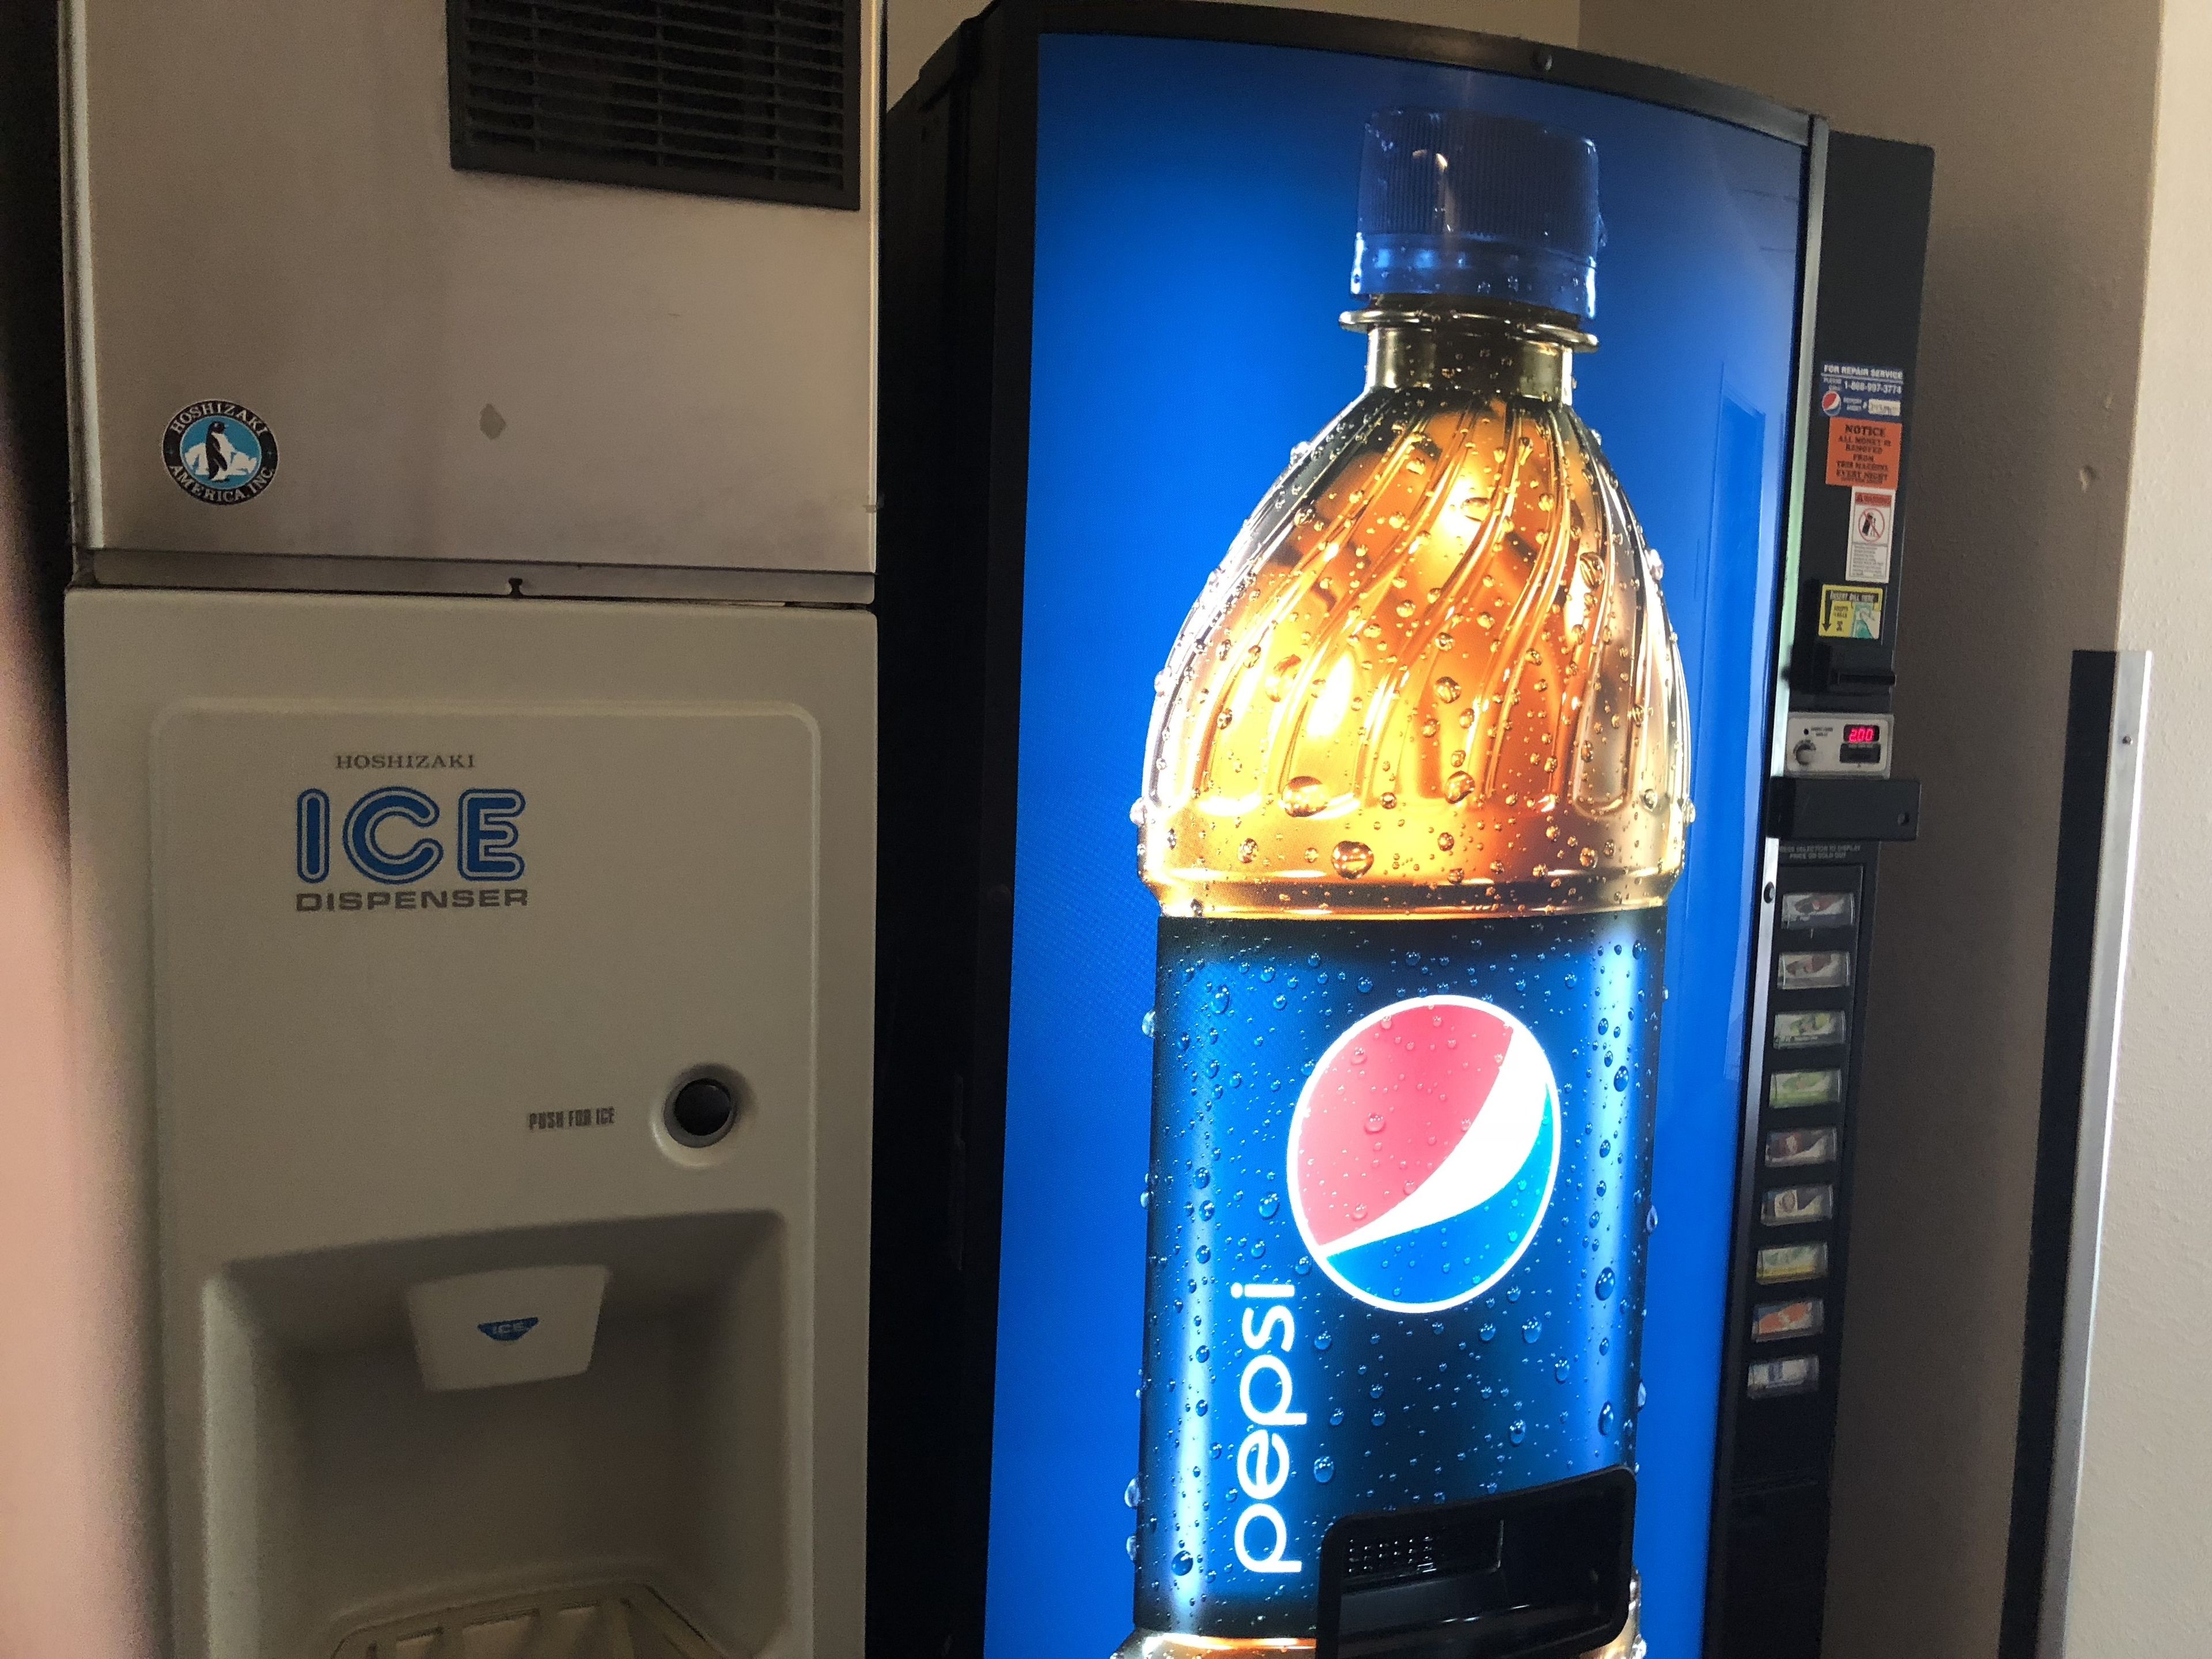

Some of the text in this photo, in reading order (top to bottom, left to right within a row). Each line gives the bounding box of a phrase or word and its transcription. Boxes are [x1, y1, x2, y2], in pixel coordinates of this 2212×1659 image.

[1824, 364, 1903, 380] FOR REPAIR SERVICE
[171, 403, 268, 435] HOSHIZAKI
[1845, 425, 1886, 437] NOTICE
[1855, 436, 1881, 446] MONEY
[1853, 454, 1874, 462] FROM
[335, 753, 475, 770] HOSHIZAKI
[296, 786, 527, 885] ICE
[296, 888, 529, 912] DISPENSER
[529, 1106, 615, 1130] PUSH FOR ICE
[493, 1322, 524, 1334] ICE
[1230, 1282, 1308, 1573] pepsi
